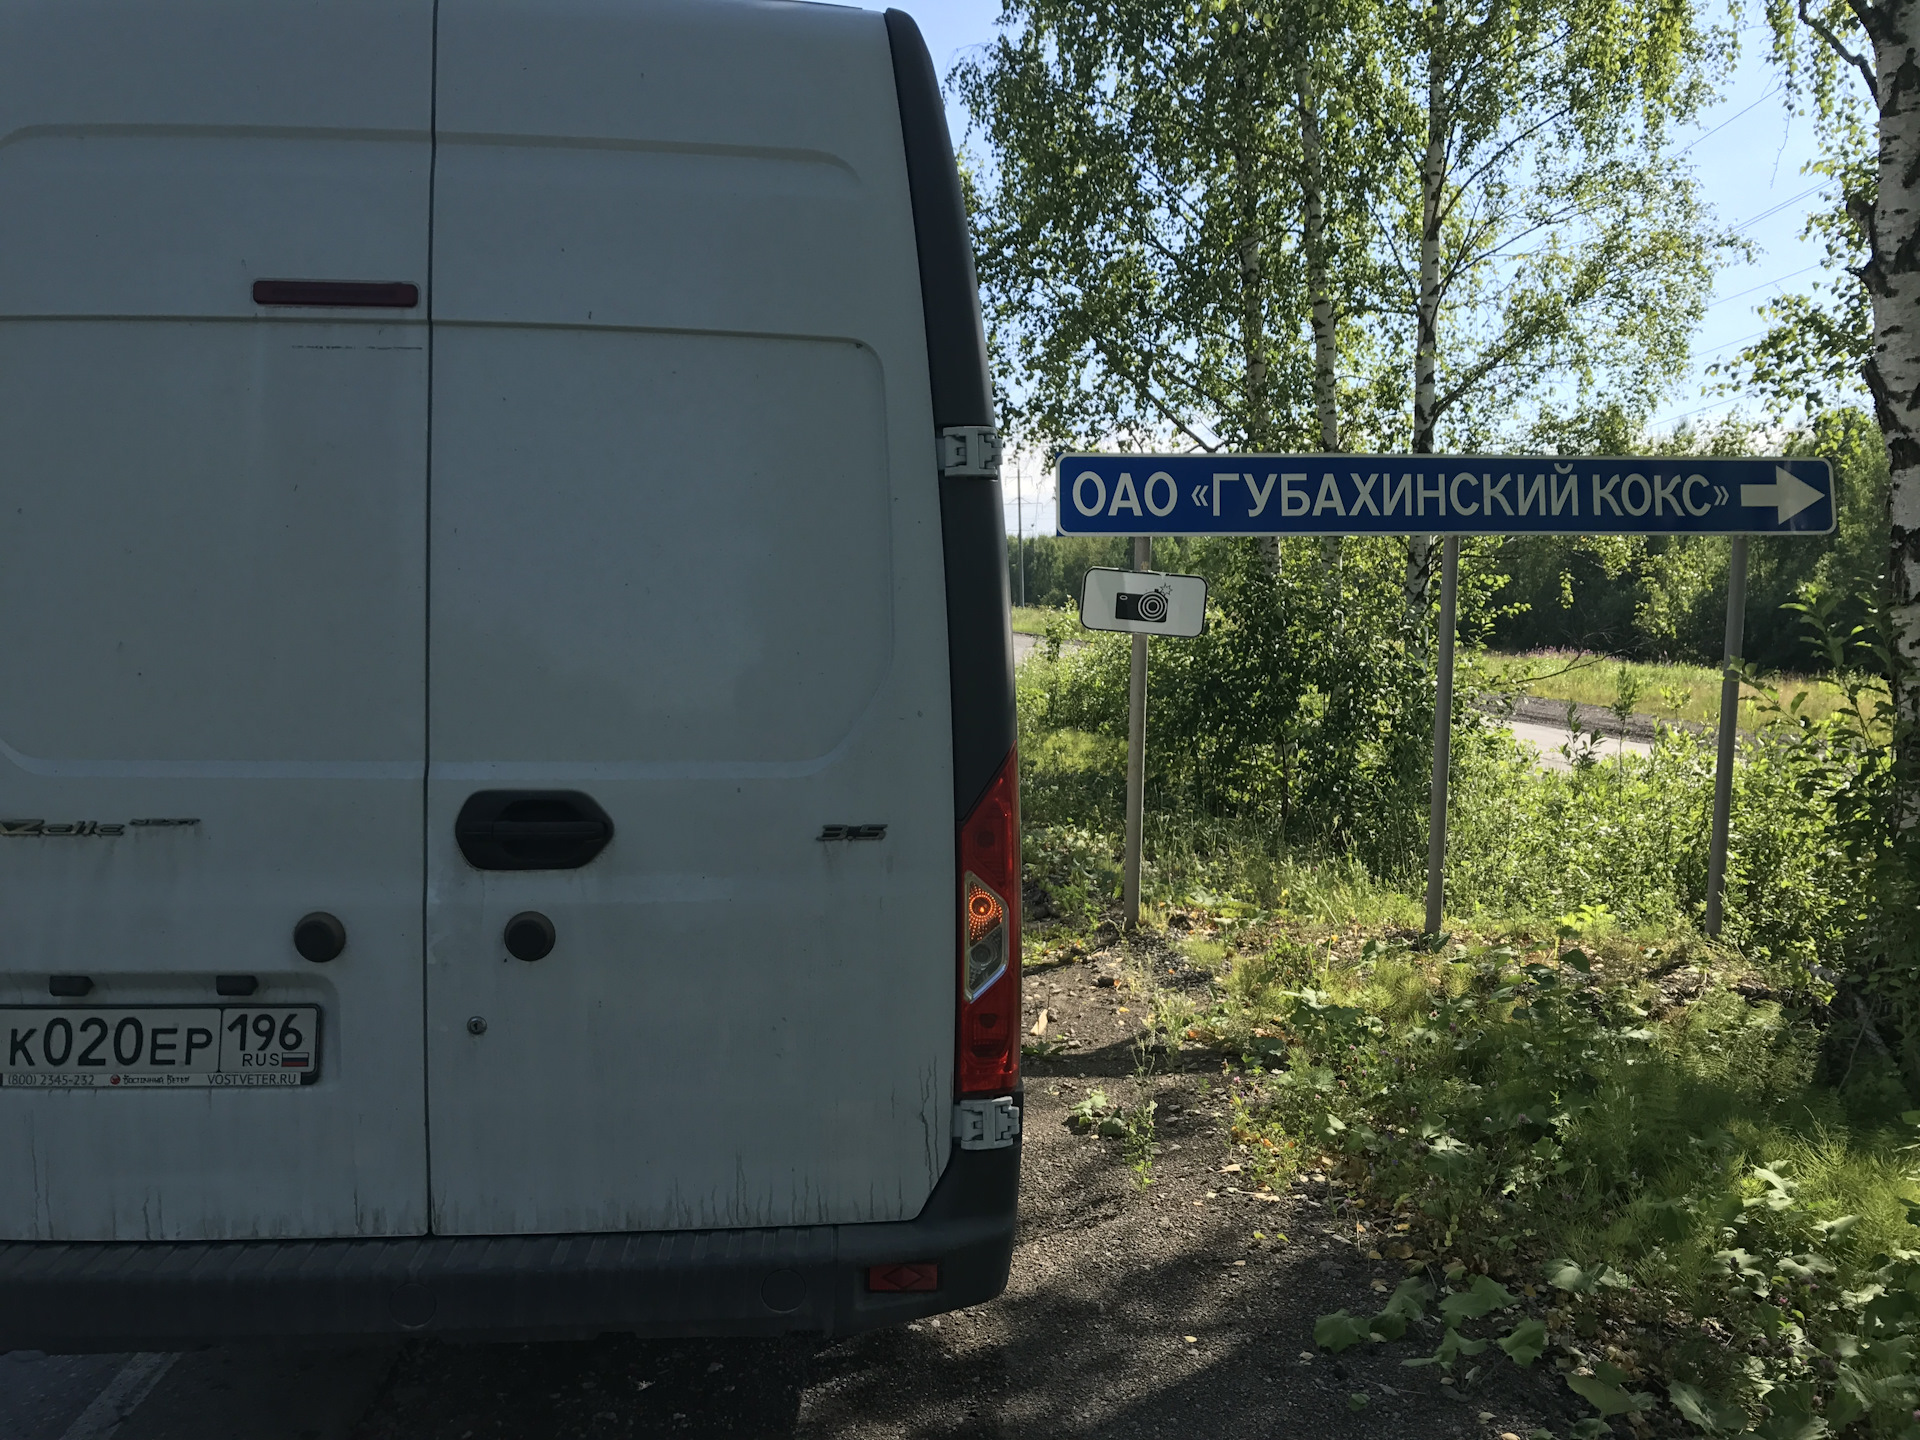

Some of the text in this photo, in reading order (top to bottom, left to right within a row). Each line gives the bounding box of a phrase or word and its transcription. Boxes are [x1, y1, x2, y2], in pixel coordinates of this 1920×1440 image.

[1072, 463, 1730, 517] ОАО «ГУБАХИНСКИЙ КОКС»
[0, 818, 125, 837] Zelle
[227, 1013, 303, 1052] 196
[242, 1053, 280, 1067] RUS
[8, 1074, 95, 1086] (800) 2345-232
[207, 1073, 297, 1085] VOSTVETER.RU
